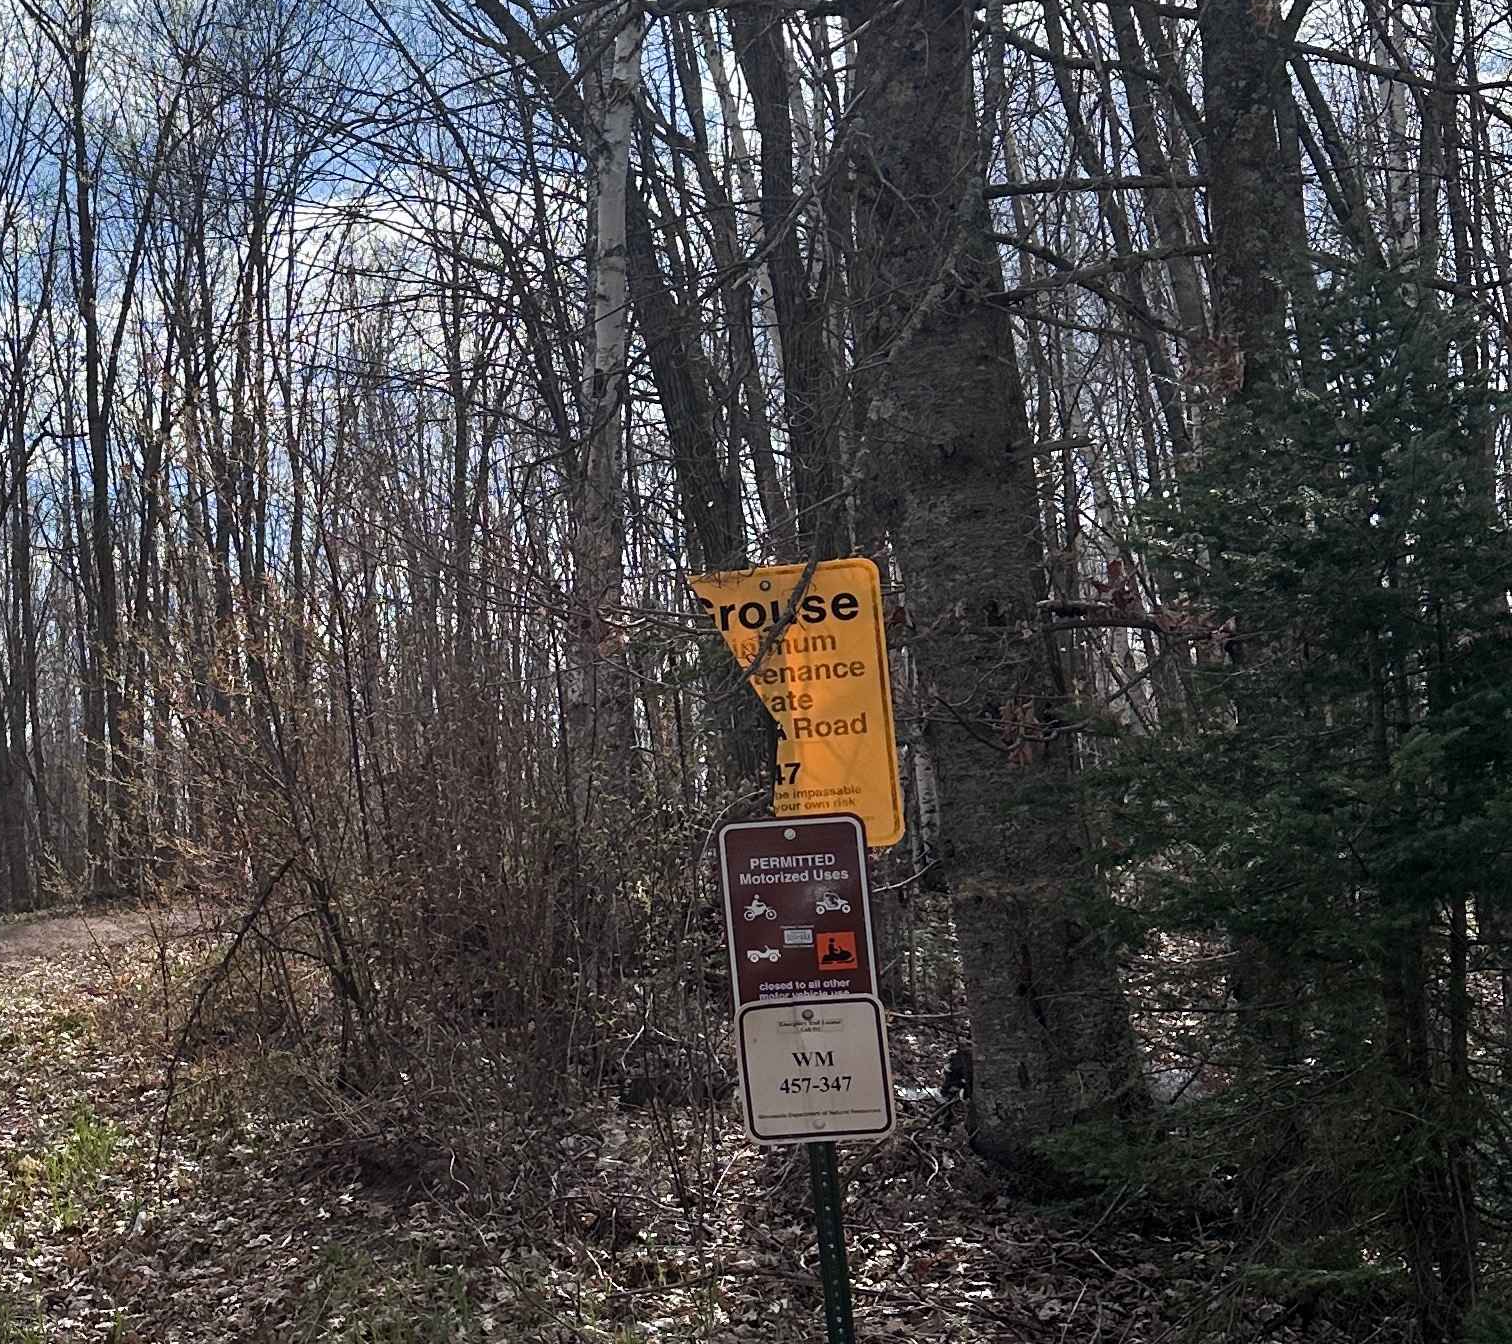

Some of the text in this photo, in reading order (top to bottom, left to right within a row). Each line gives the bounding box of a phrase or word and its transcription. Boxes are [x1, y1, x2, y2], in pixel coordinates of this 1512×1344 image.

[732, 635, 837, 656] inmum
[765, 690, 814, 713] ate
[793, 712, 867, 739] Road
[793, 785, 862, 799] impassable
[804, 800, 830, 809] own
[833, 797, 857, 807] risk
[750, 854, 836, 870] PERMITTED
[739, 869, 849, 886] Motorized Uses
[760, 978, 851, 991] closed to all other
[791, 1050, 834, 1067] WM
[779, 1075, 852, 1094] 457-347
